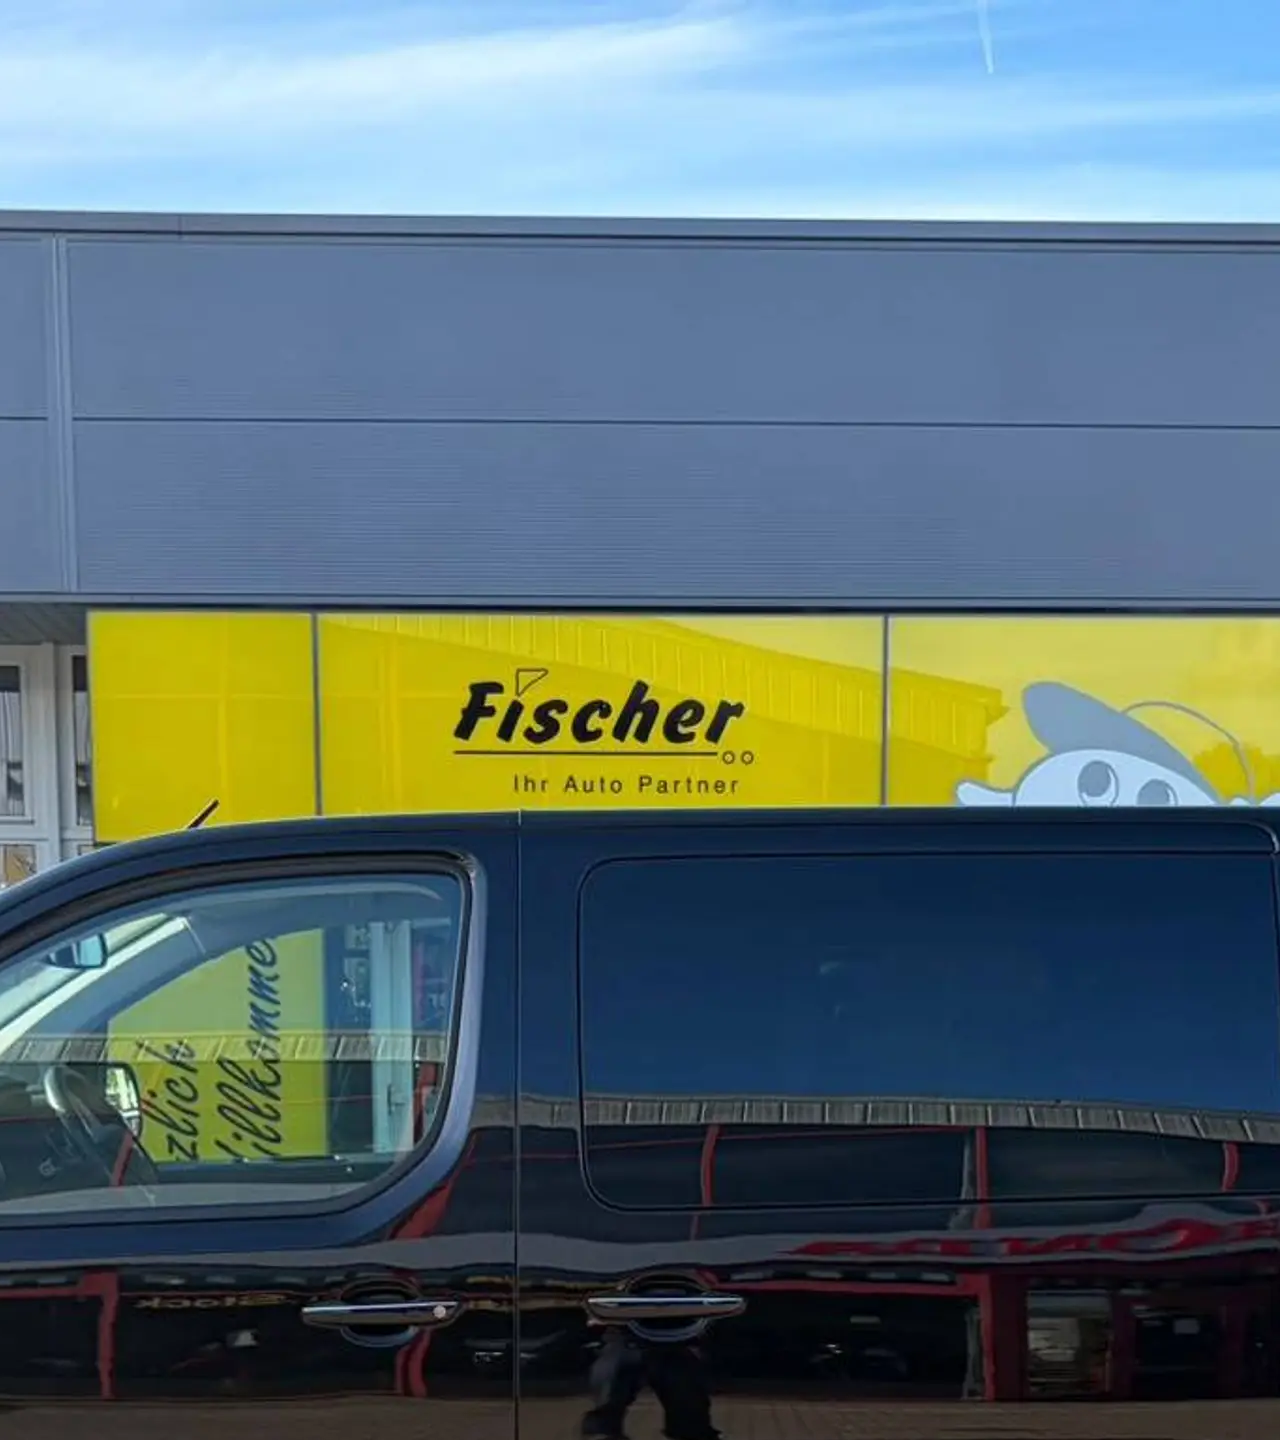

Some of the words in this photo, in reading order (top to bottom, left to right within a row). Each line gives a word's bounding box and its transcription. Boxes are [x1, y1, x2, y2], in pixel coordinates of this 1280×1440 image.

[452, 679, 745, 745] Fischer
[513, 774, 549, 794] Ihr
[563, 774, 624, 795] Auto
[638, 775, 740, 796] Partner
